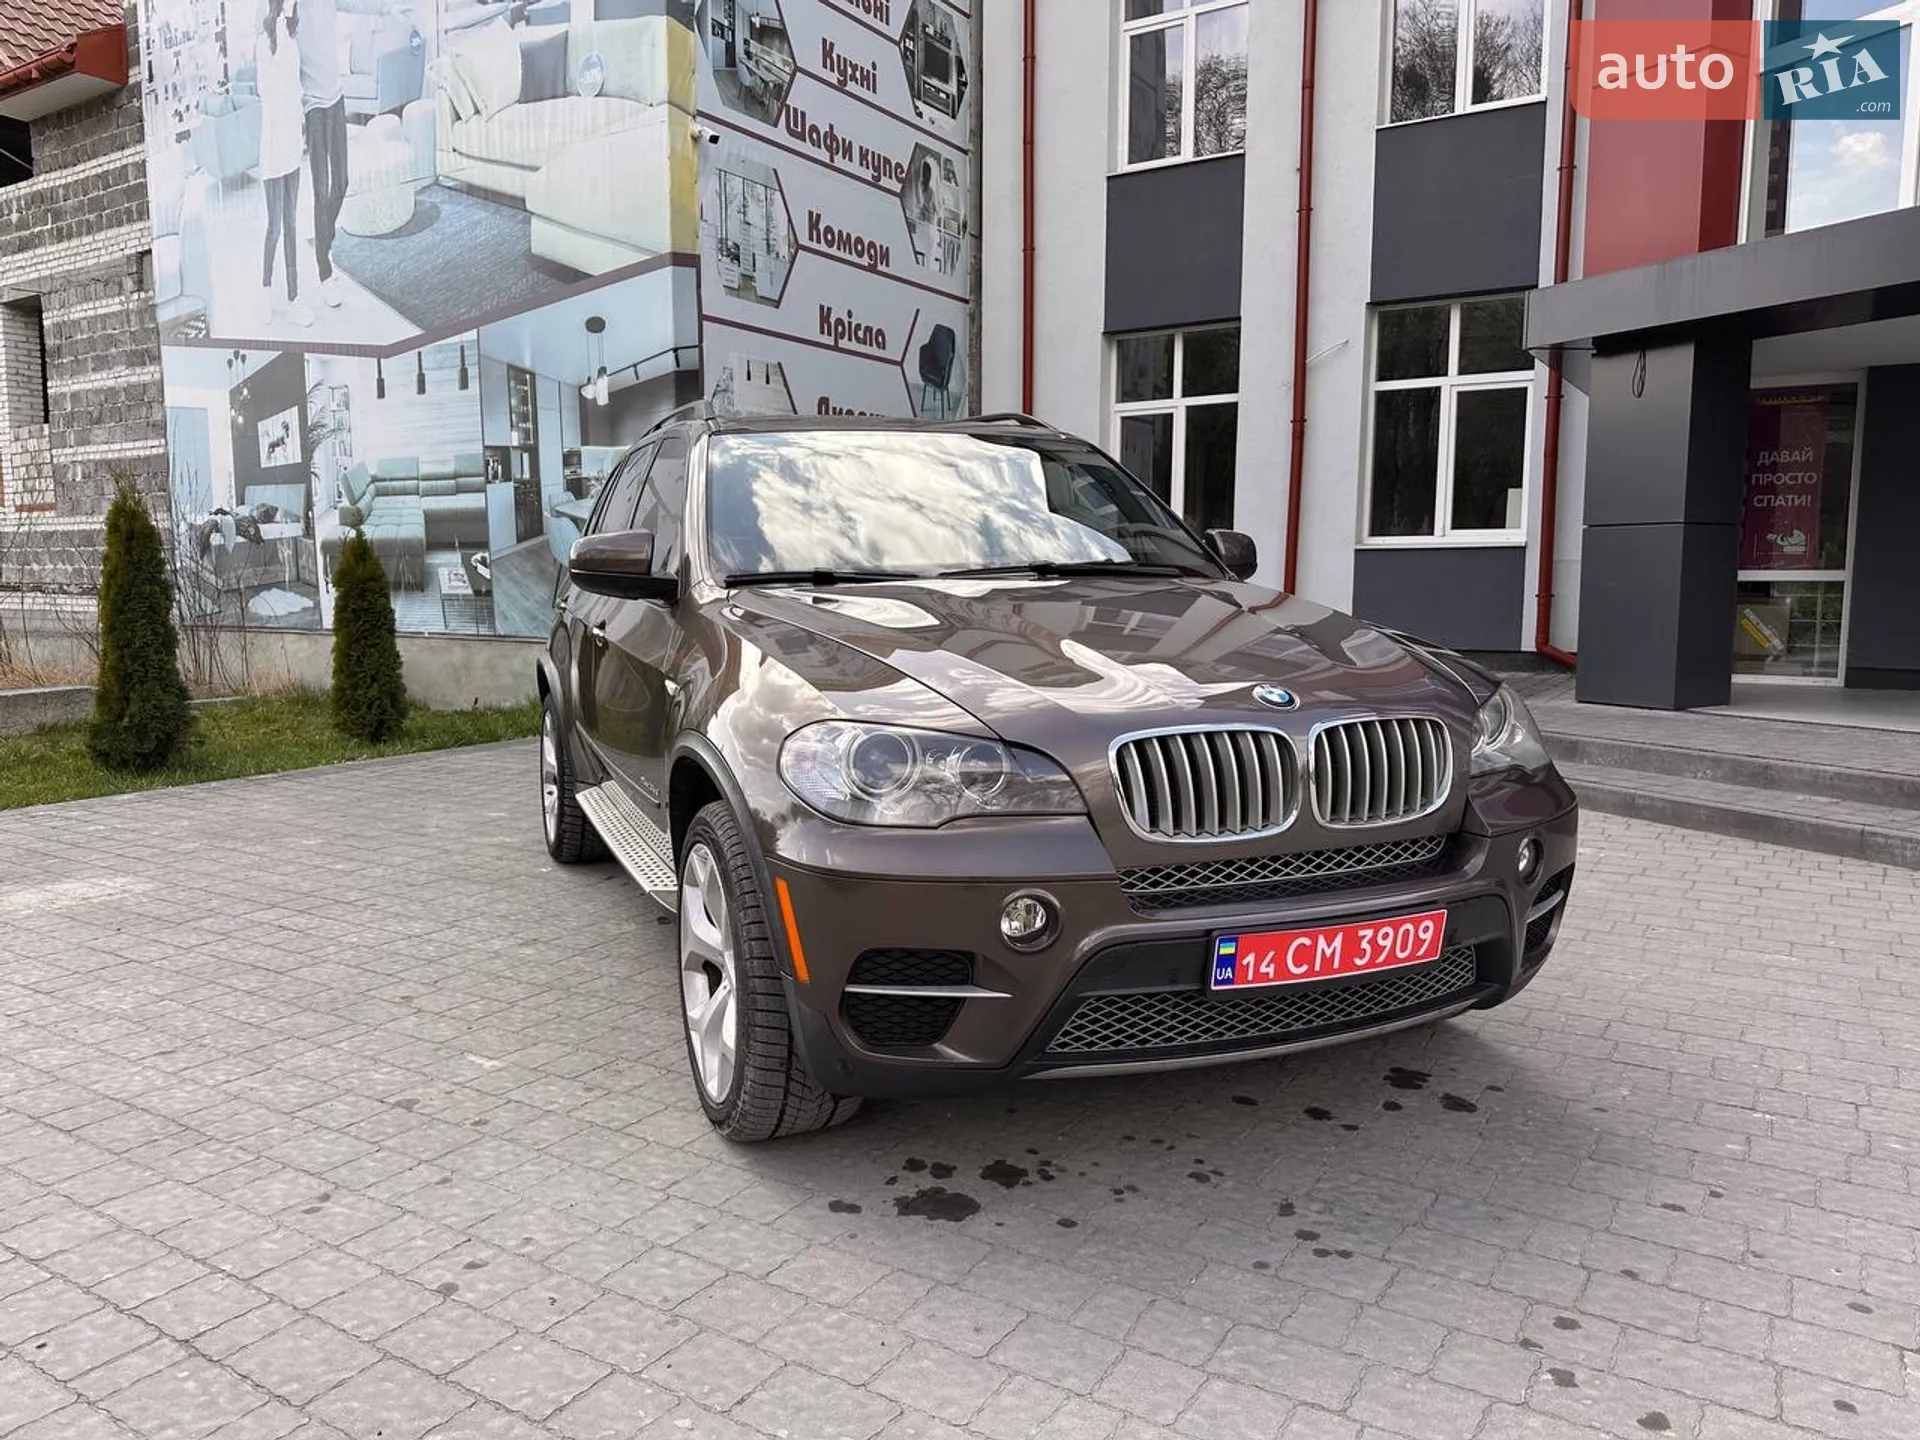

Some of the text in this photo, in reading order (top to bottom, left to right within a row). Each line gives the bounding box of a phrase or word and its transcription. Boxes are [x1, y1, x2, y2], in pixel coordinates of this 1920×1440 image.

[821, 37, 878, 95] Кухні
[783, 104, 907, 184] Шафи купе
[807, 210, 890, 269] Комоди
[818, 304, 887, 351] Крісла
[1752, 472, 1818, 486] ПРОСТО
[1757, 446, 1814, 466] ДАВАЙ
[1753, 494, 1812, 508] СПАТИ!
[1216, 967, 1233, 981] UA
[1241, 920, 1435, 981] 14 CM 3909
